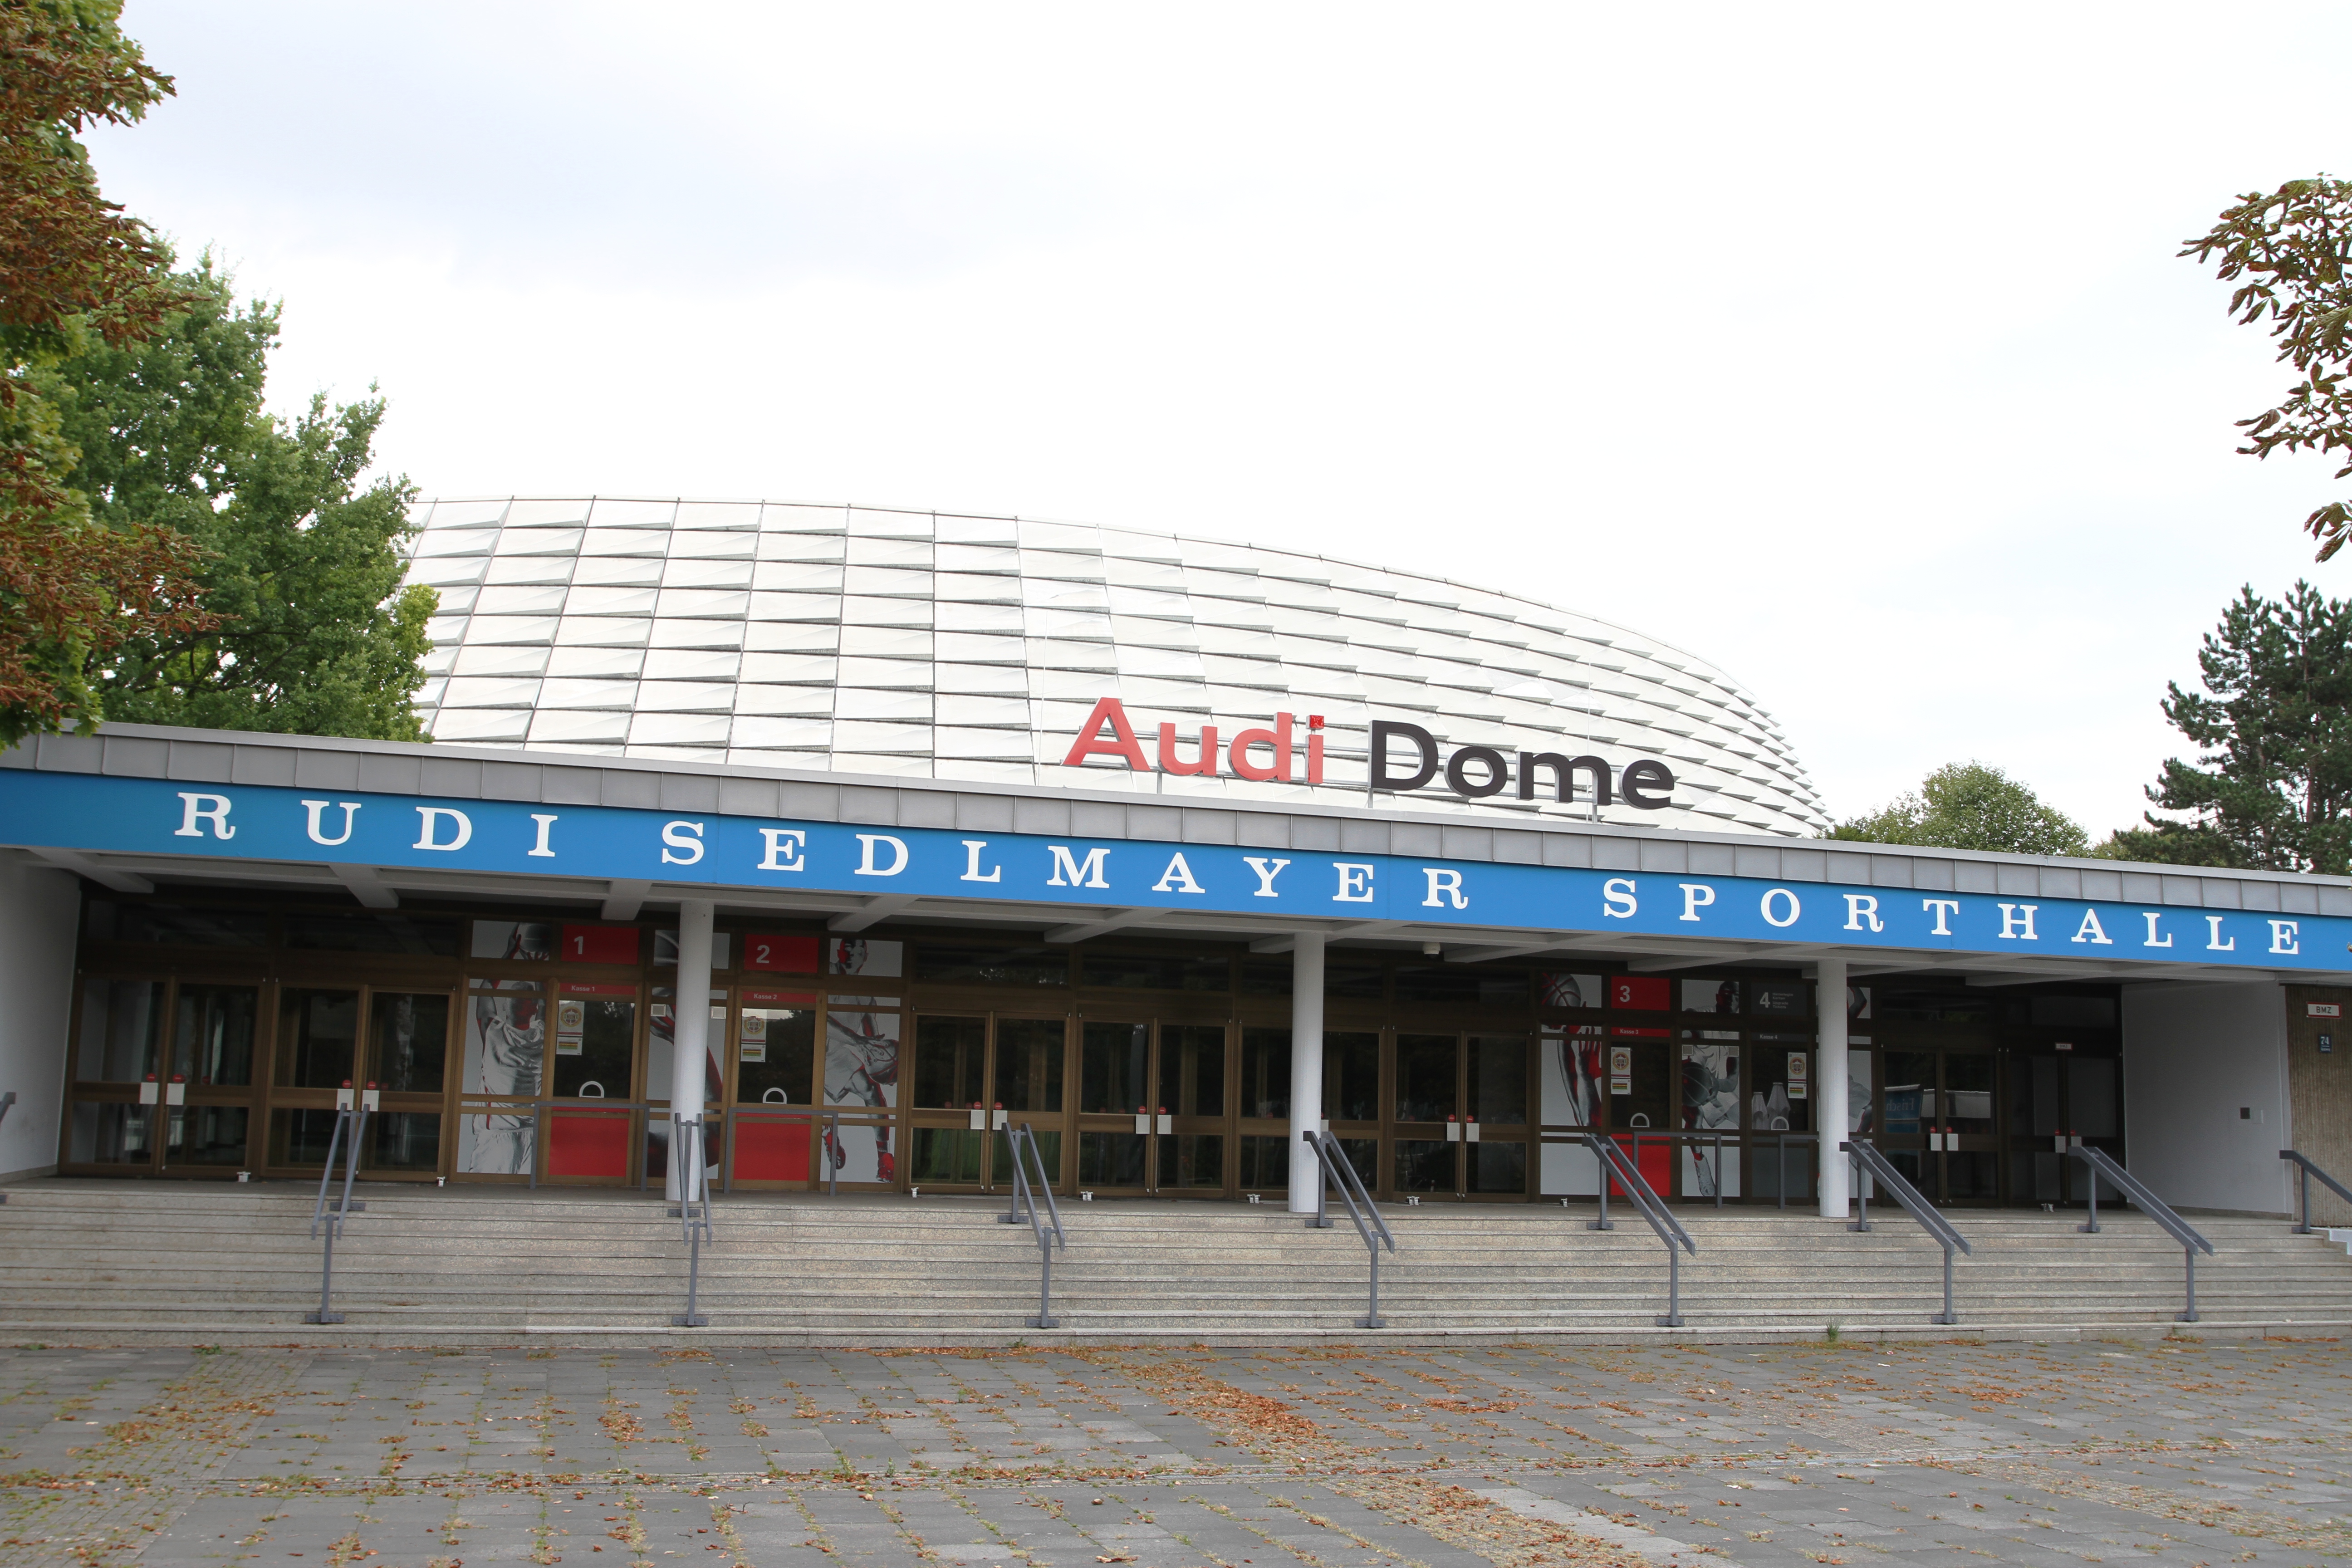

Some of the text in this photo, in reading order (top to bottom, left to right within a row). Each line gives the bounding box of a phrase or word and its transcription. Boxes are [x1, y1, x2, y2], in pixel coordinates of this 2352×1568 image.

[1060, 697, 1675, 810] Audi Dome
[174, 792, 2299, 955] RUDI SEDLMAYER SPORTHALLE
[574, 936, 583, 955] 1
[756, 945, 770, 964] 2
[1620, 985, 1630, 1002] 3
[1760, 992, 1770, 1008] 4
[2321, 1036, 2329, 1044] 74
